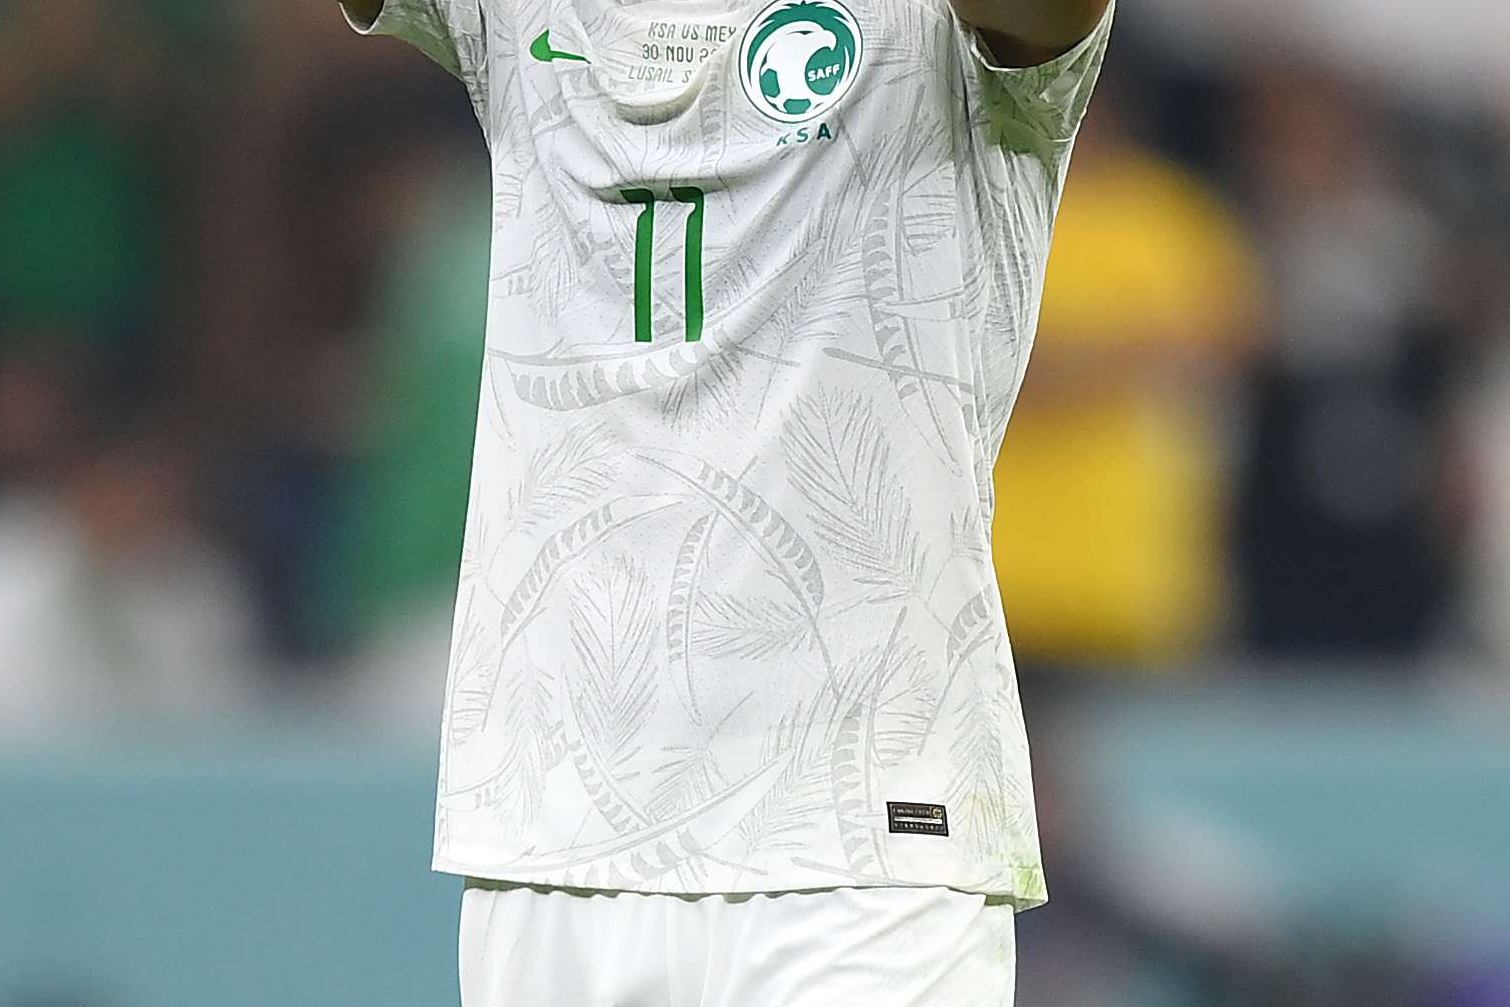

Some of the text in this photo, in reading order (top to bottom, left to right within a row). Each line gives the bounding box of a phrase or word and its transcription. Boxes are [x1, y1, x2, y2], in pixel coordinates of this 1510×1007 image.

[648, 21, 677, 40] KSA
[642, 43, 659, 60] 30
[627, 65, 675, 83] LUSAIL
[807, 63, 841, 82] SAFF
[776, 122, 832, 146] KSA
[619, 186, 705, 342] 11
